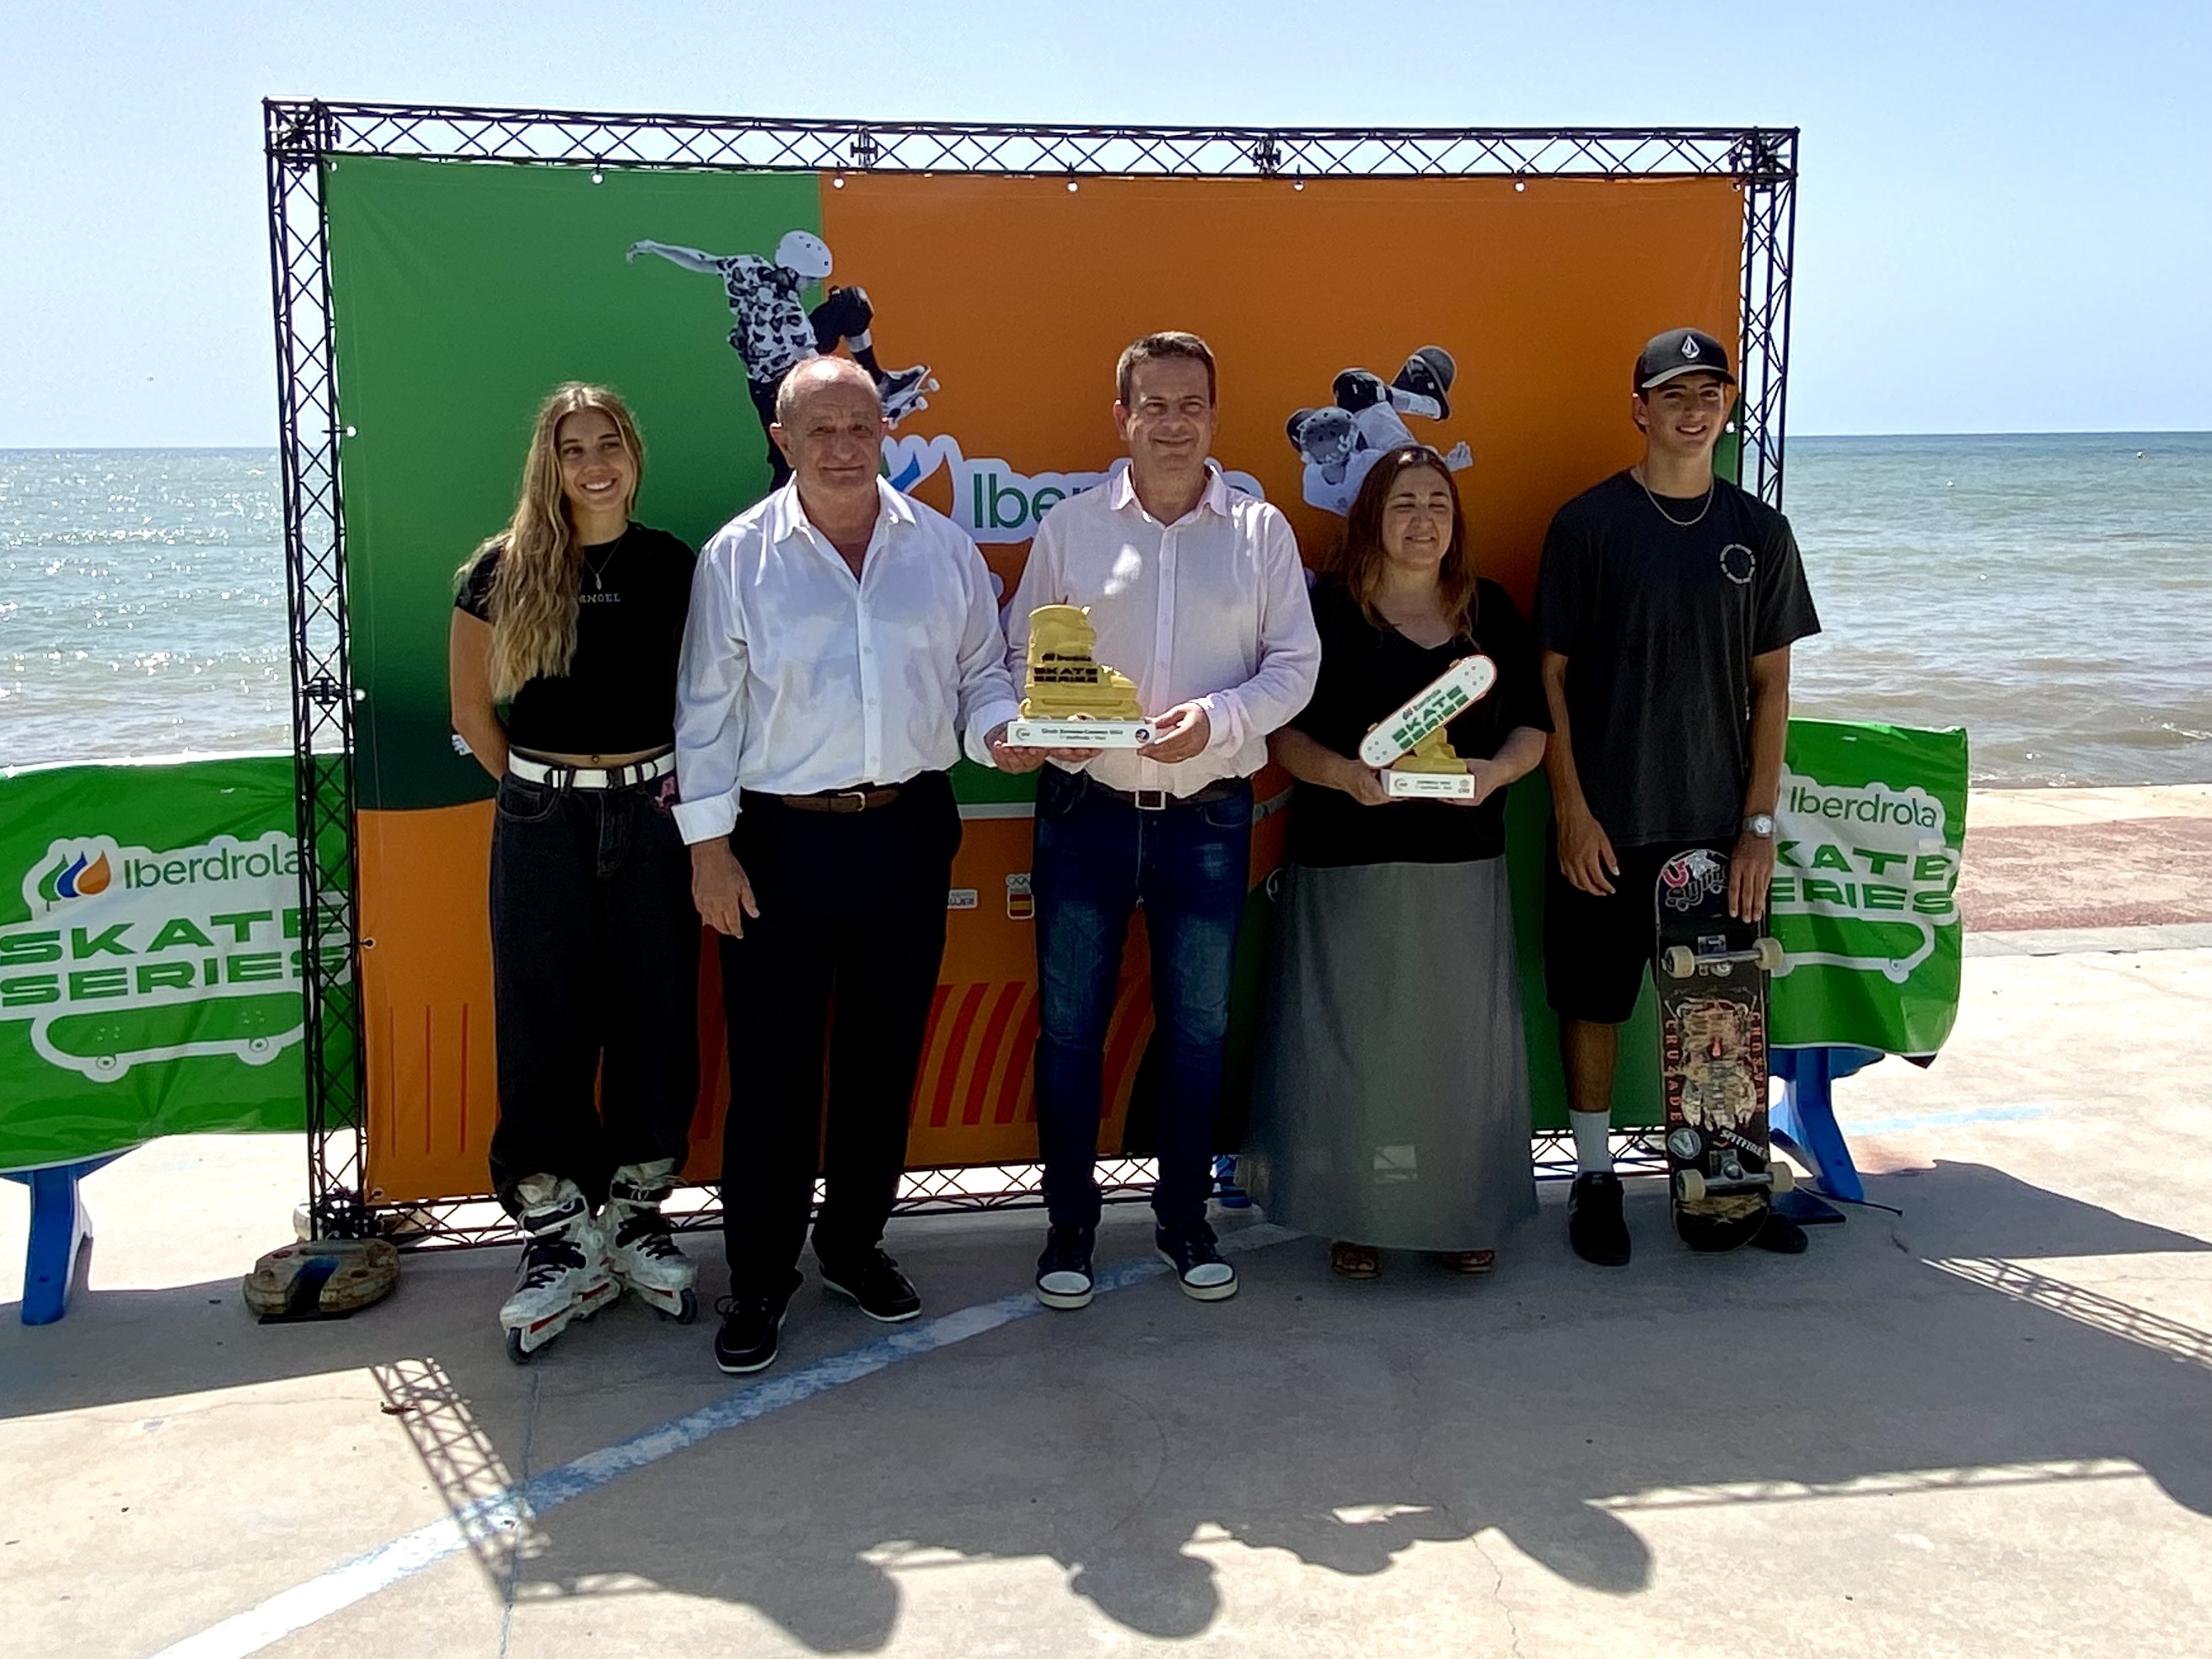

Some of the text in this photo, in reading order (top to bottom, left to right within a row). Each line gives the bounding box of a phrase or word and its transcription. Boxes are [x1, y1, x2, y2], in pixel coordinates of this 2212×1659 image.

[1789, 786, 1938, 829] Iberdrola
[124, 843, 300, 889] Iberdrola
[1776, 840, 1952, 881] KATE
[1770, 877, 1954, 915] ERIES
[0, 903, 342, 966] SKATE
[1, 946, 346, 1007] SERIES
